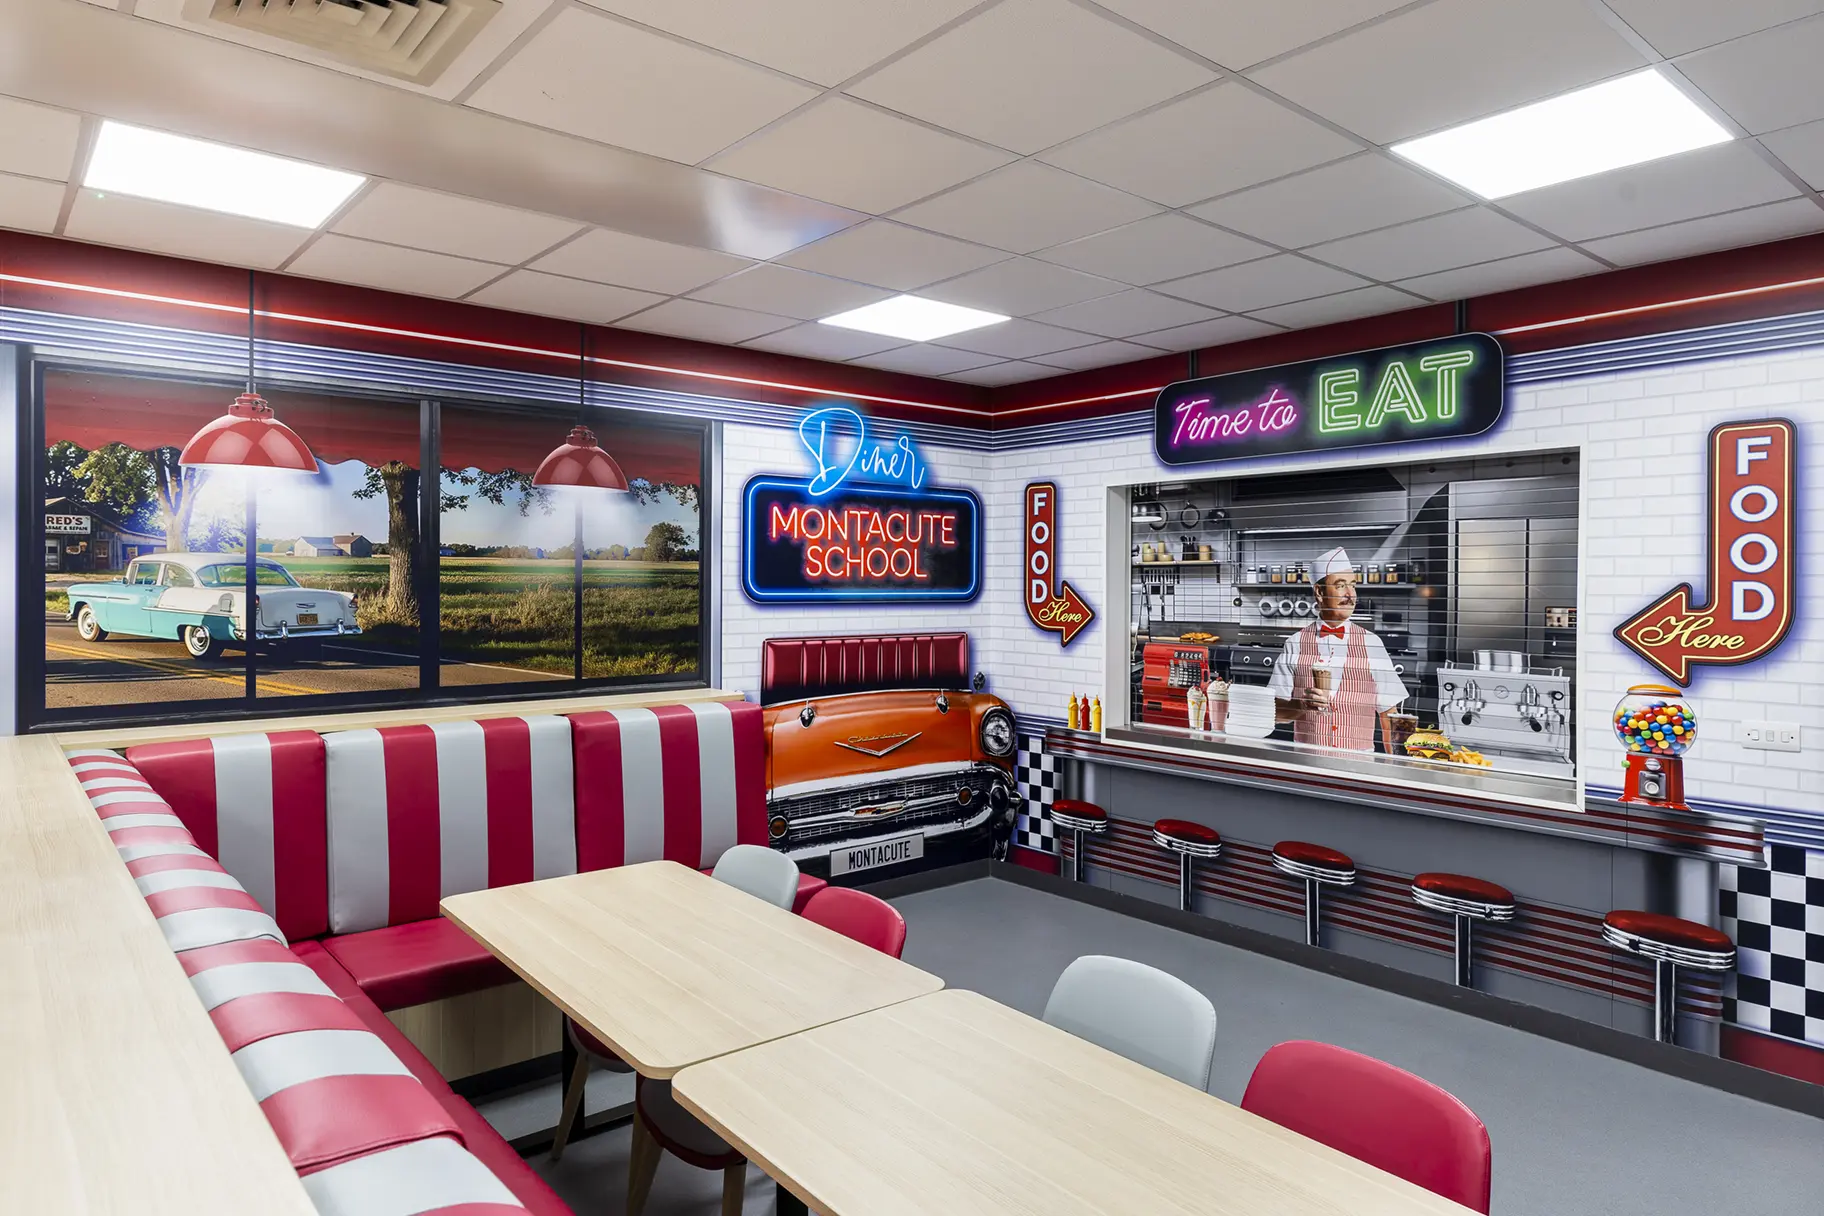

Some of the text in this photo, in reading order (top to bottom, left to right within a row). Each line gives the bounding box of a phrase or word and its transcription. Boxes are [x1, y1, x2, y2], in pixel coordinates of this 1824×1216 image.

[1173, 350, 1474, 445] Time to EAT
[799, 407, 925, 496] Diner
[46, 516, 83, 525] RED'S
[771, 506, 956, 545] MONTACUTE
[1728, 435, 1779, 622] FOOD
[805, 545, 928, 578] SCHOOL
[1031, 492, 1050, 604] FOOD
[1038, 601, 1083, 623] Here
[1637, 614, 1746, 651] Here
[848, 840, 911, 870] MONTACUTE
